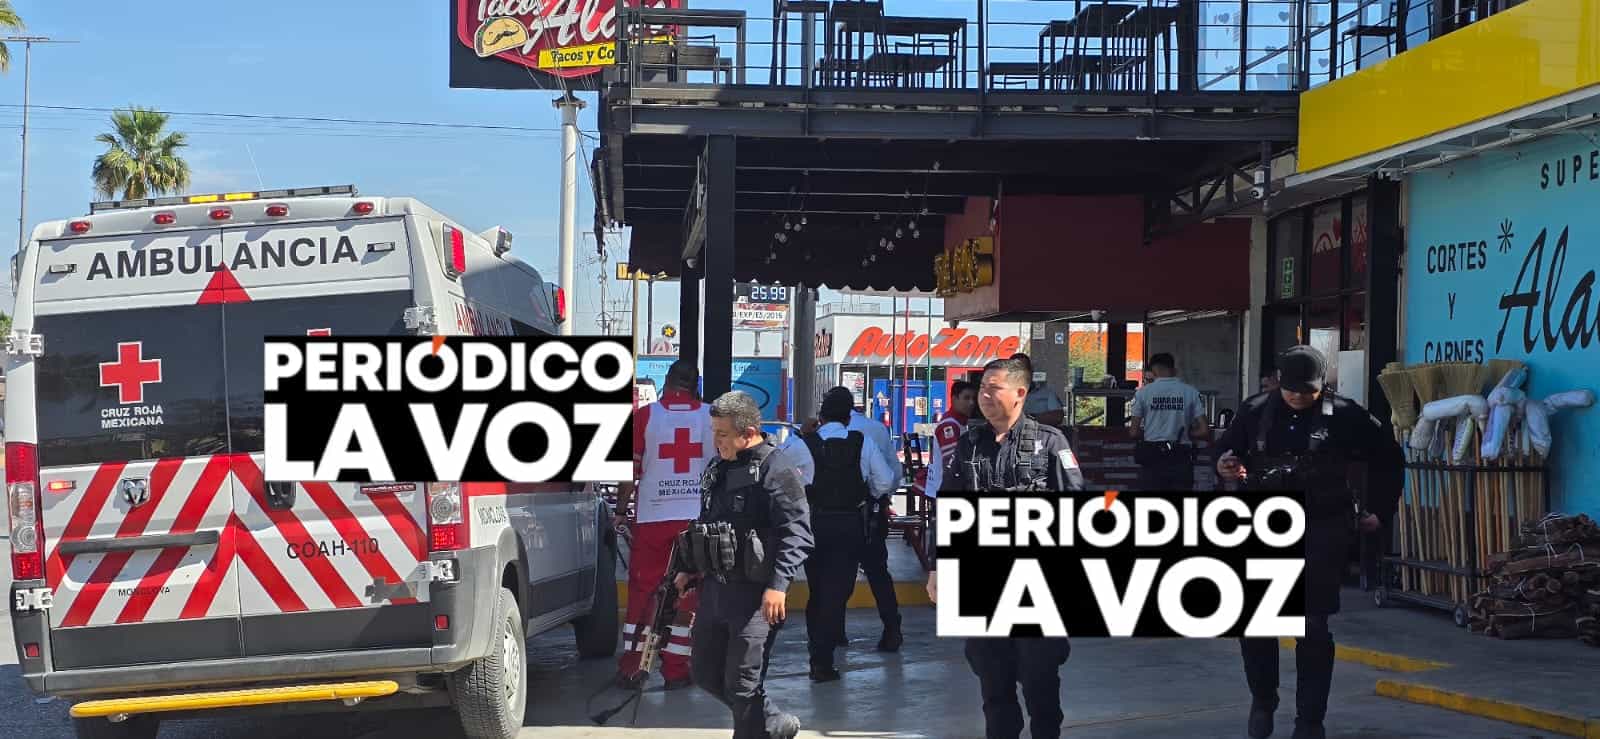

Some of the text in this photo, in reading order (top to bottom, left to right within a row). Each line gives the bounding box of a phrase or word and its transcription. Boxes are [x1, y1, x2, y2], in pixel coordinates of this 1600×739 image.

[551, 46, 616, 64] Tacos y Co
[86, 235, 358, 281] AMBULANCIA
[1427, 241, 1487, 274] CORTES
[751, 286, 786, 300] 25.99
[1496, 224, 1600, 354] Ala
[1448, 293, 1456, 320] Y
[848, 326, 1020, 360] AutoZone
[1424, 339, 1484, 365] CARNES
[101, 404, 164, 418] CRUZ ROJA
[101, 416, 164, 429] MEXICANA
[286, 538, 380, 560] COAH-110
